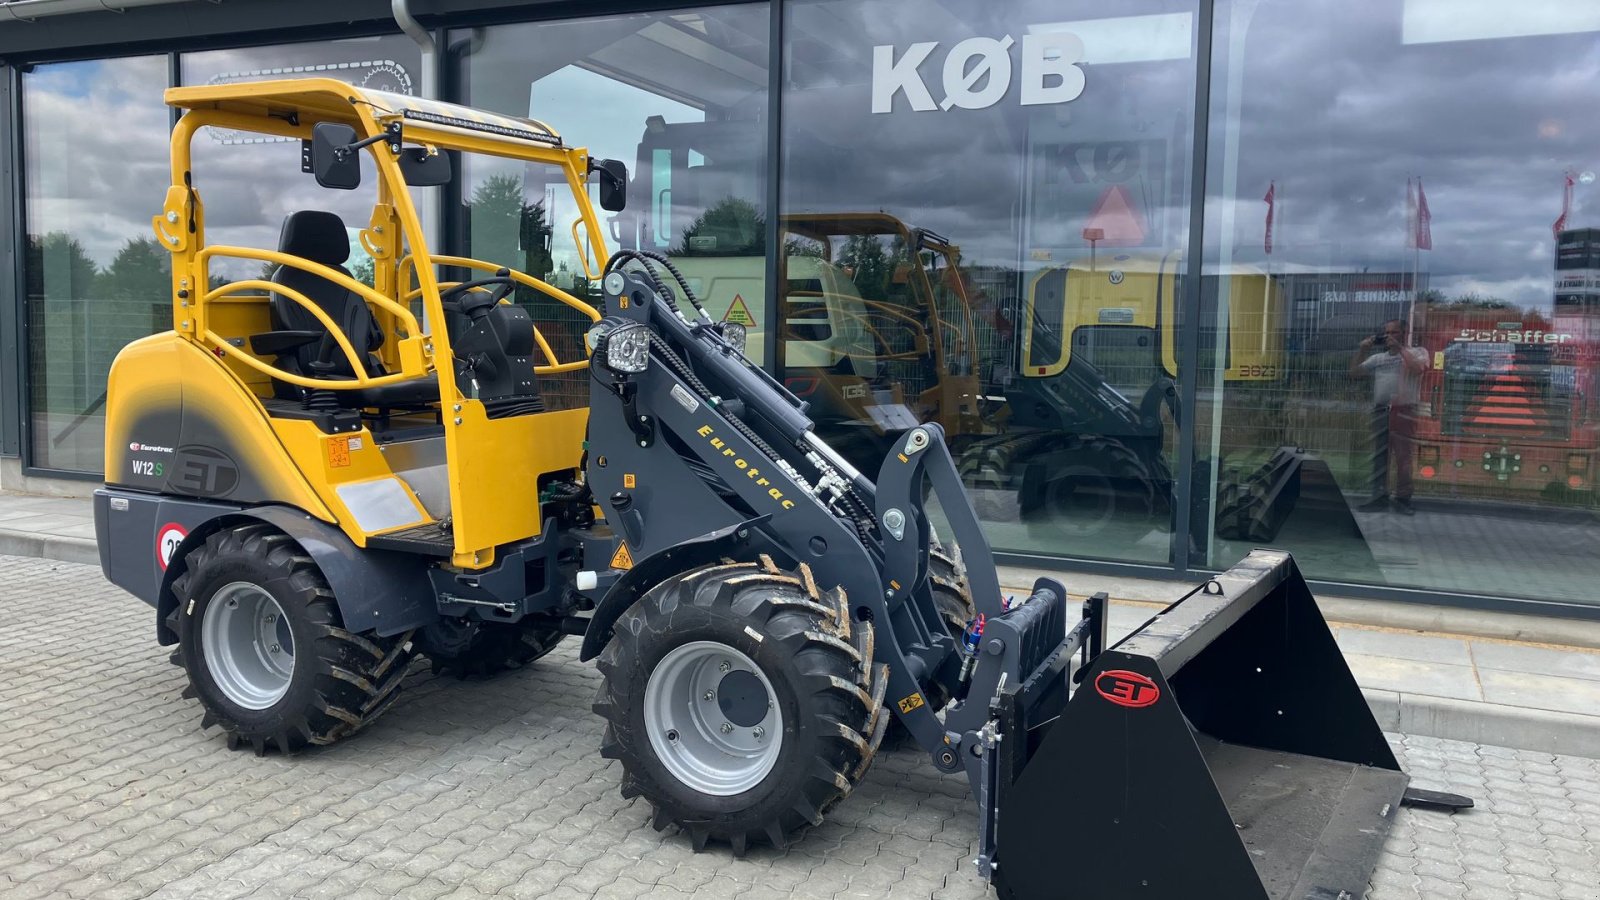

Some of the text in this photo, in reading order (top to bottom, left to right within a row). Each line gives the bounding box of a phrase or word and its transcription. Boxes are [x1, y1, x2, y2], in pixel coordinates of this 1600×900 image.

[871, 32, 1086, 114] KØB
[140, 444, 174, 453] Eurotrac
[132, 460, 154, 475] W12
[697, 425, 795, 510] Eurotrac
[1096, 670, 1159, 707] ET
